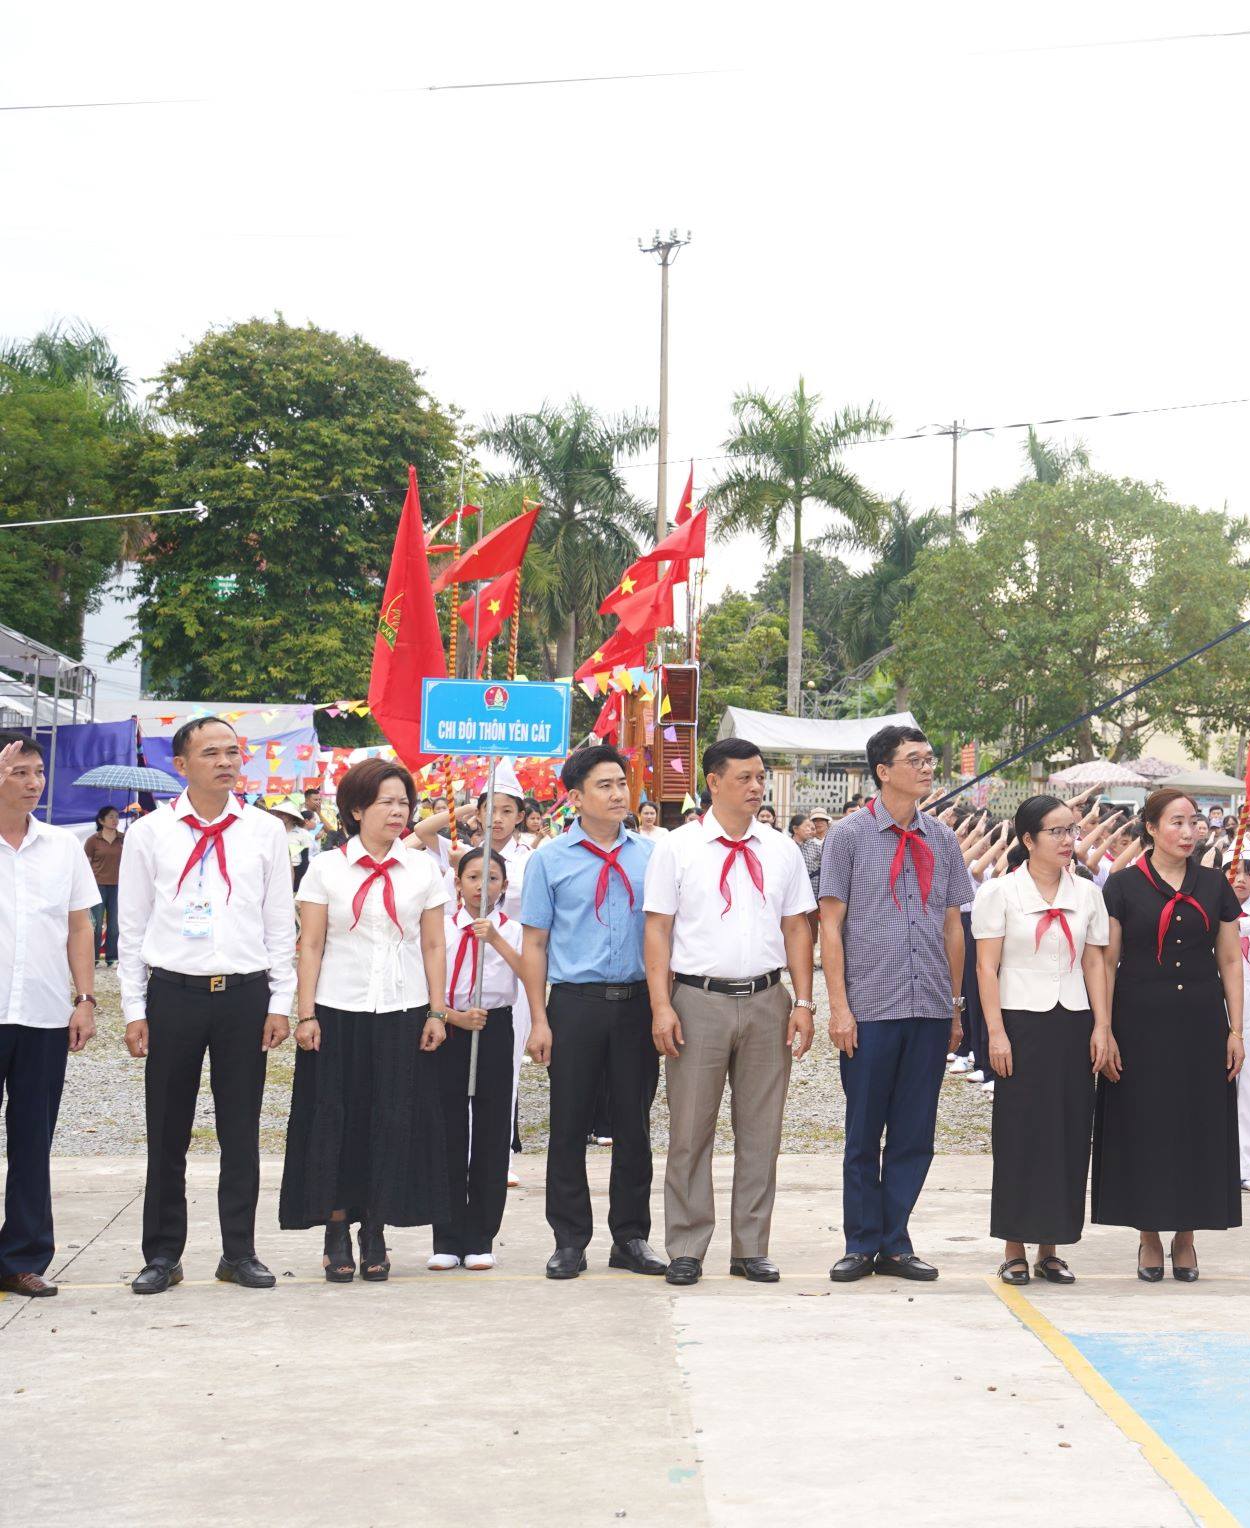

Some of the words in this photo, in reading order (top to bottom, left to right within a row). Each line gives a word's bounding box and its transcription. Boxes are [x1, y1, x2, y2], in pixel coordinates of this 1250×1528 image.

[438, 720, 456, 740] CHI
[458, 717, 476, 744] ĐỘI
[479, 718, 506, 741] THÔN
[509, 719, 529, 742] YÊN
[531, 720, 552, 743] CÁT
